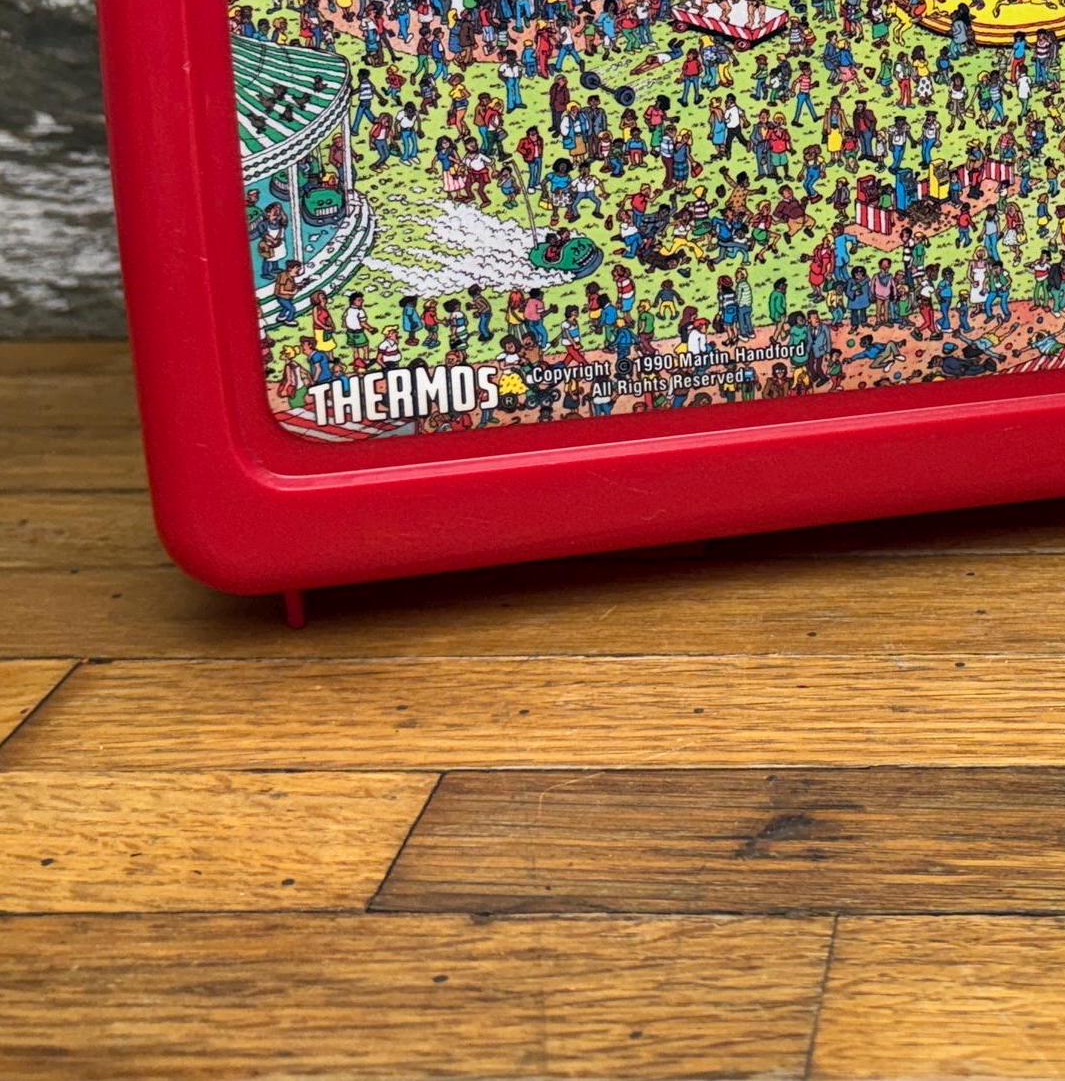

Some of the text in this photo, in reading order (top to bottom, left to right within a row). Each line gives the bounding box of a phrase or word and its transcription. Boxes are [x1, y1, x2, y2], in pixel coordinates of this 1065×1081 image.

[532, 360, 610, 384] Copyright
[634, 355, 673, 372] 1990
[679, 350, 729, 368] Martin
[735, 342, 805, 363] Handford
[307, 365, 499, 427] THERMOS
[592, 381, 612, 398] All
[617, 376, 667, 397] Rights
